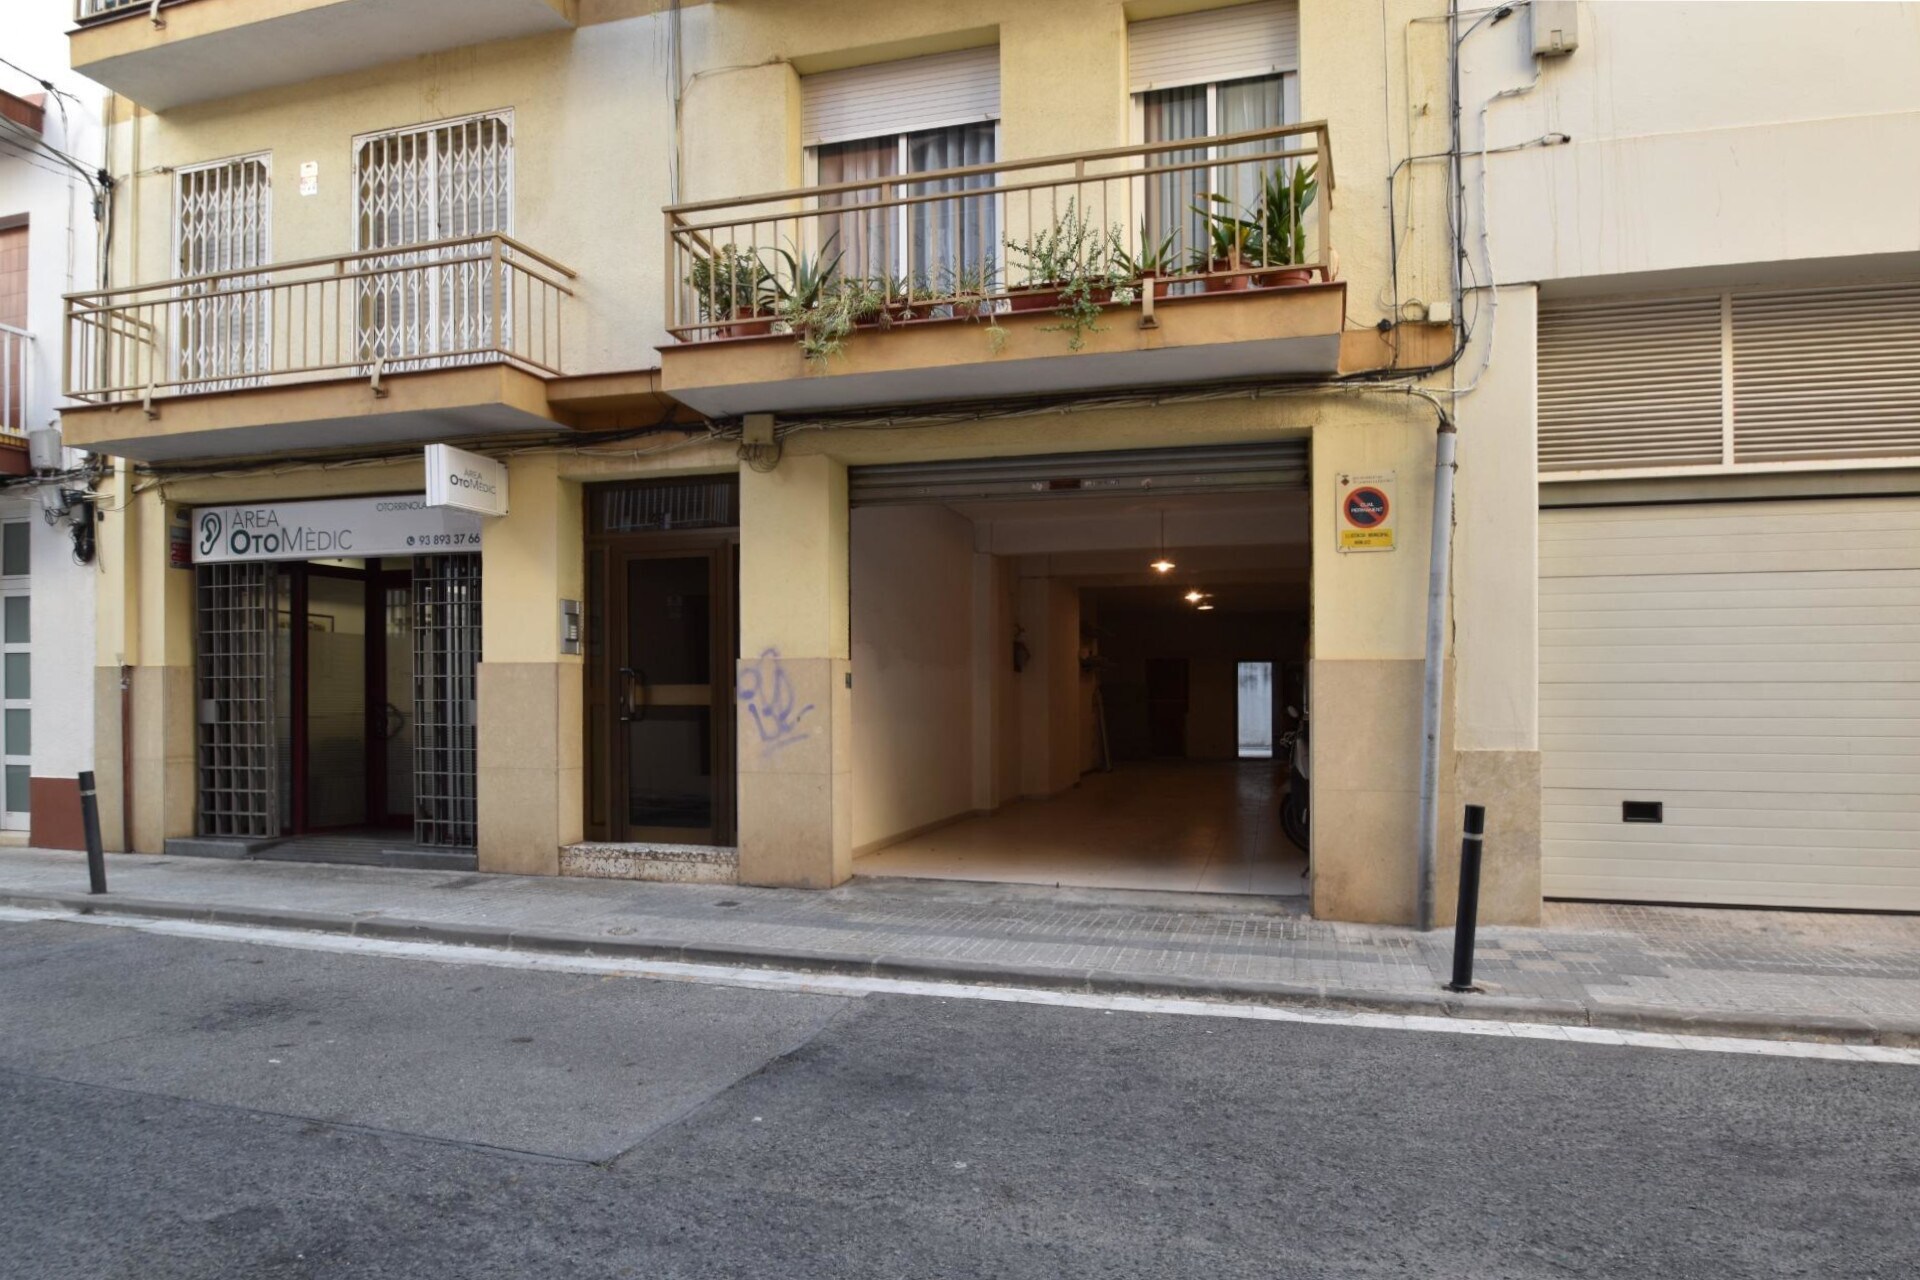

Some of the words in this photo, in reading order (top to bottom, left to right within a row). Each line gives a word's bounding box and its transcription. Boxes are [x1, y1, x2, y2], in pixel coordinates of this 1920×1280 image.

[231, 509, 280, 529] ÀREA
[418, 535, 431, 546] 93
[433, 534, 451, 546] 893
[453, 533, 466, 545] 37
[468, 532, 481, 544] 66
